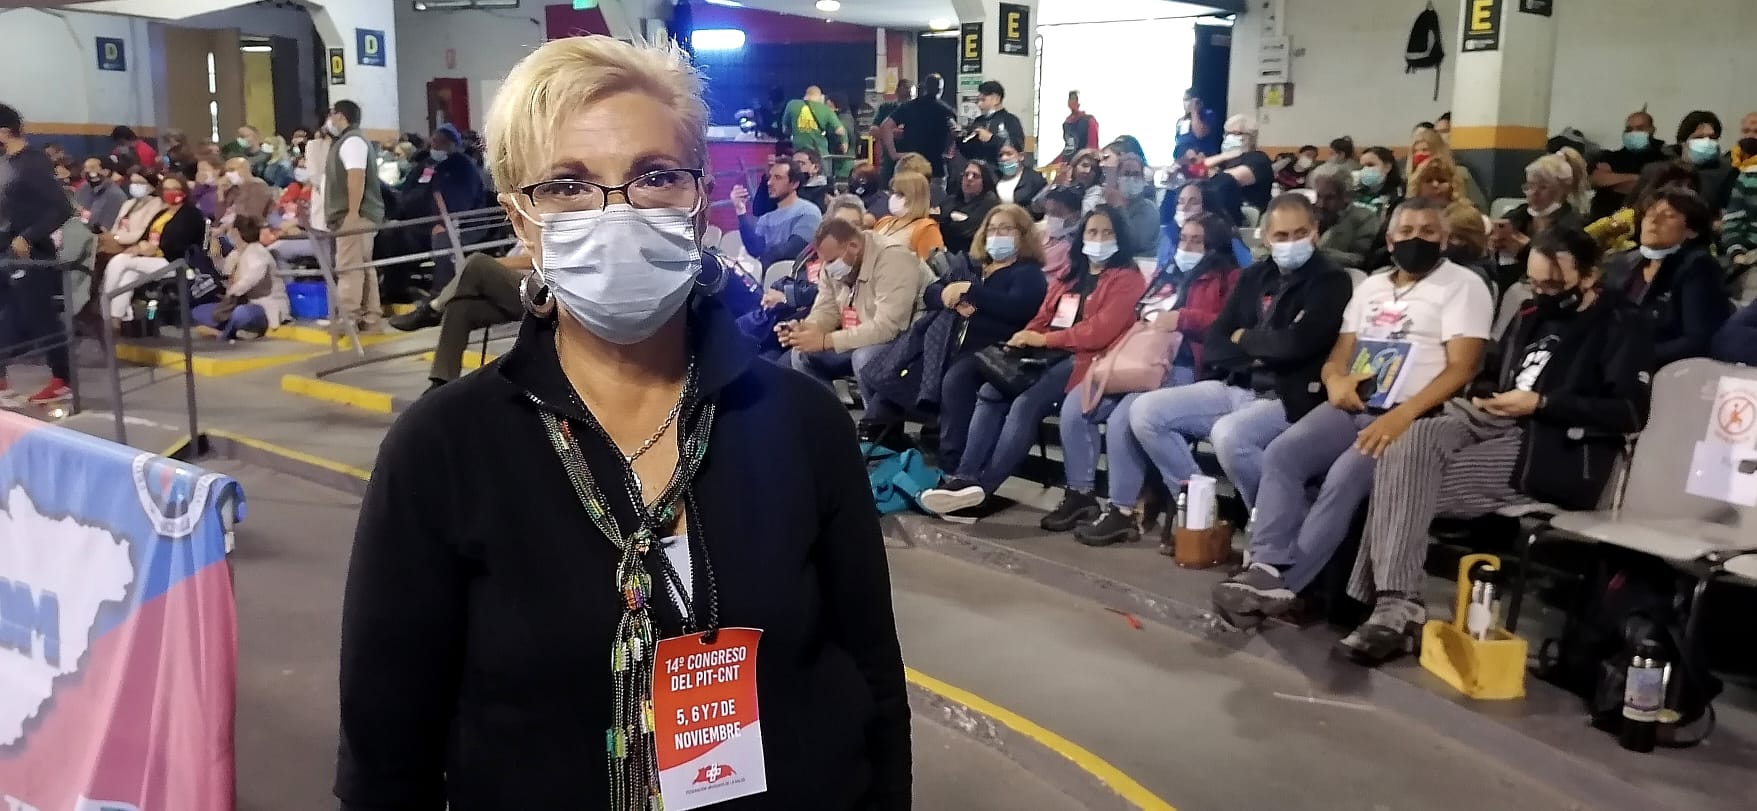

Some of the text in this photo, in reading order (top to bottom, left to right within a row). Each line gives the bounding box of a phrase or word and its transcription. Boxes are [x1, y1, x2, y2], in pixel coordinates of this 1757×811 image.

[1007, 12, 1020, 38] E
[1471, 0, 1494, 30] E
[364, 34, 378, 55] D
[965, 34, 978, 58] E
[687, 646, 747, 670] CONGRESO
[671, 665, 740, 692] DEL PIT-CNT
[676, 699, 736, 726] 5, 6 Y 7 DE
[674, 721, 742, 750] NOVIEMBRE
